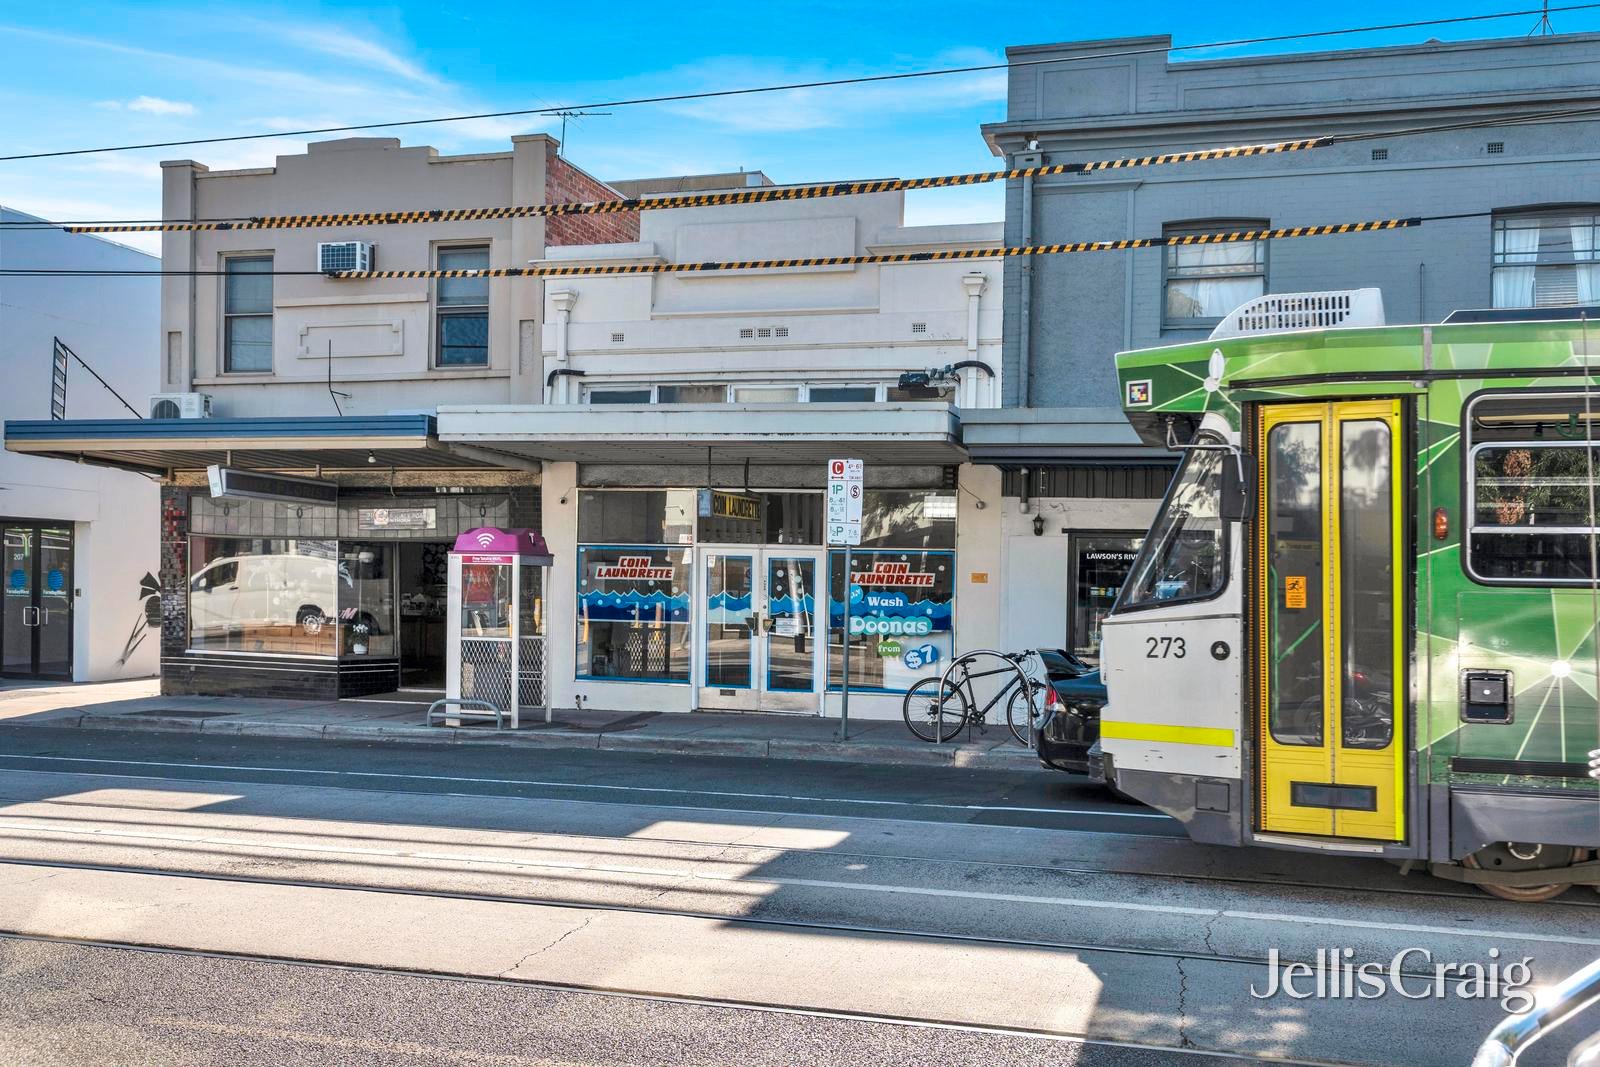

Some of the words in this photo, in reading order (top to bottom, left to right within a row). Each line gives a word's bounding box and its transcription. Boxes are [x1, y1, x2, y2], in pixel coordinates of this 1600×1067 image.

[832, 484, 844, 495] 1P
[713, 493, 727, 516] COIN
[13, 553, 25, 561] 207
[1086, 552, 1123, 560] LAWSON'S
[619, 557, 650, 568] COIN
[596, 567, 673, 579] LAUNDRETTE
[875, 563, 908, 574] COIN
[850, 573, 934, 585] LAUNDRETTE
[867, 596, 904, 607] Wash
[849, 616, 929, 633] Doonas
[877, 644, 901, 653] from
[1145, 636, 1186, 659] 273
[905, 645, 933, 669] $7
